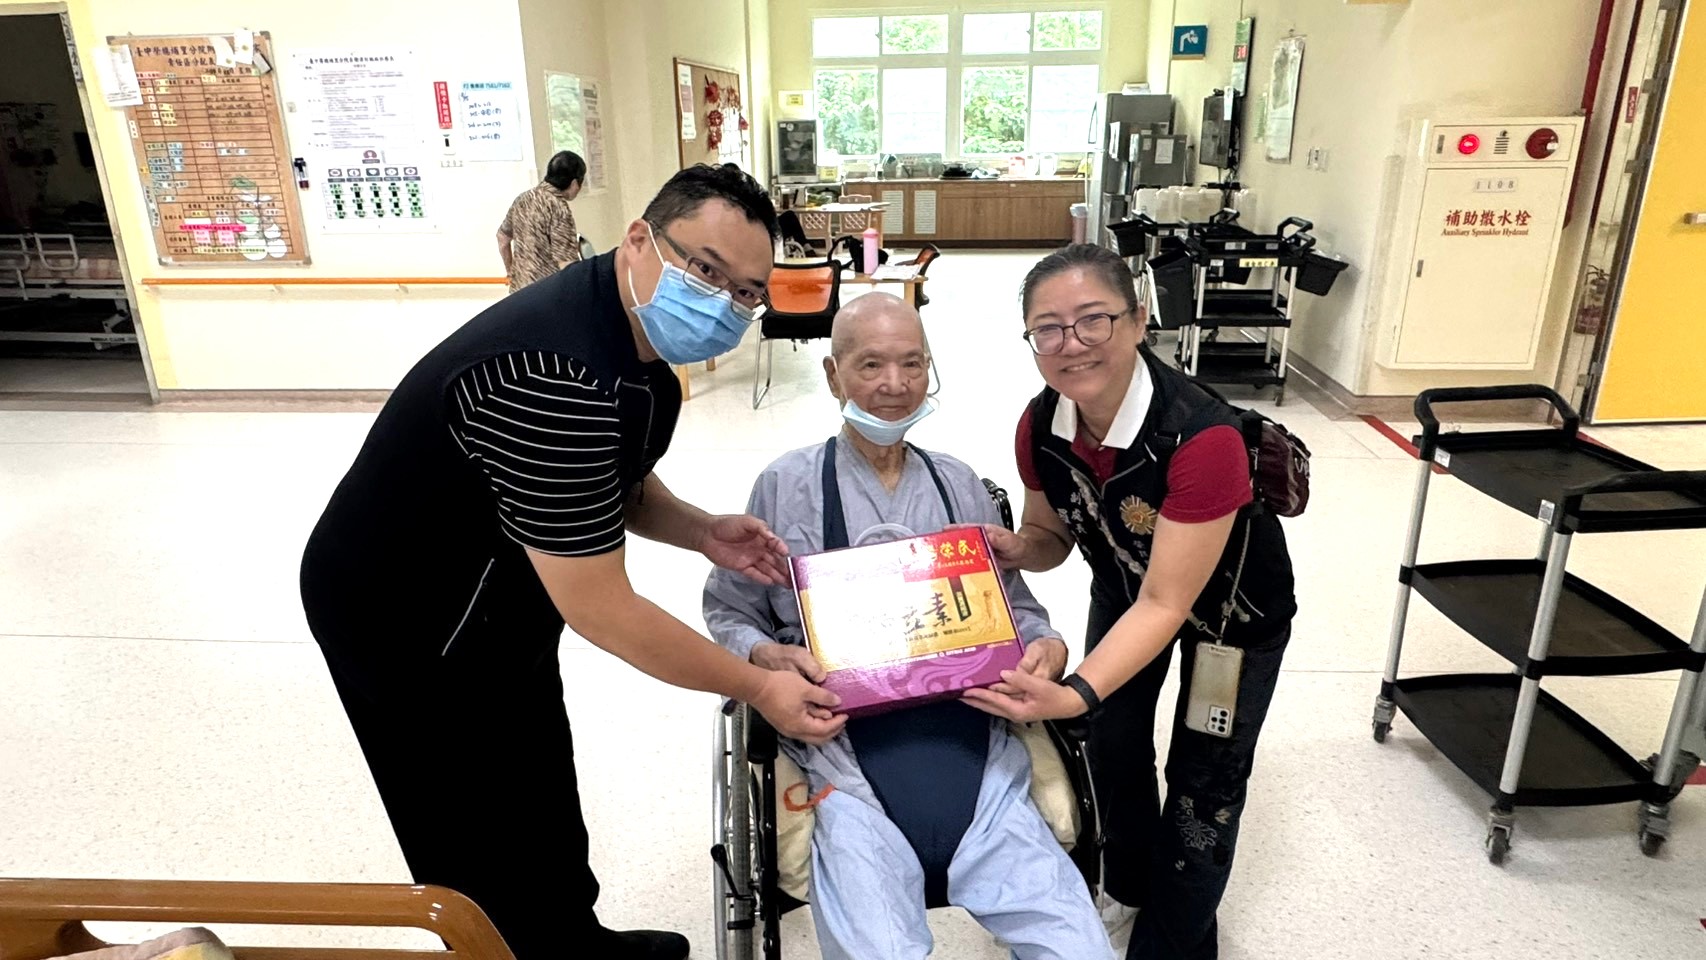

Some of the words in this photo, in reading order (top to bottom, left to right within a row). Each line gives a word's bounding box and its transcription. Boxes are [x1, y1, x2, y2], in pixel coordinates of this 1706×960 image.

[1476, 180, 1514, 190] 1108
[1445, 209, 1532, 227] 補助撒水栓
[1441, 228, 1470, 237] Auxiliary
[1502, 228, 1529, 237] Hydrant
